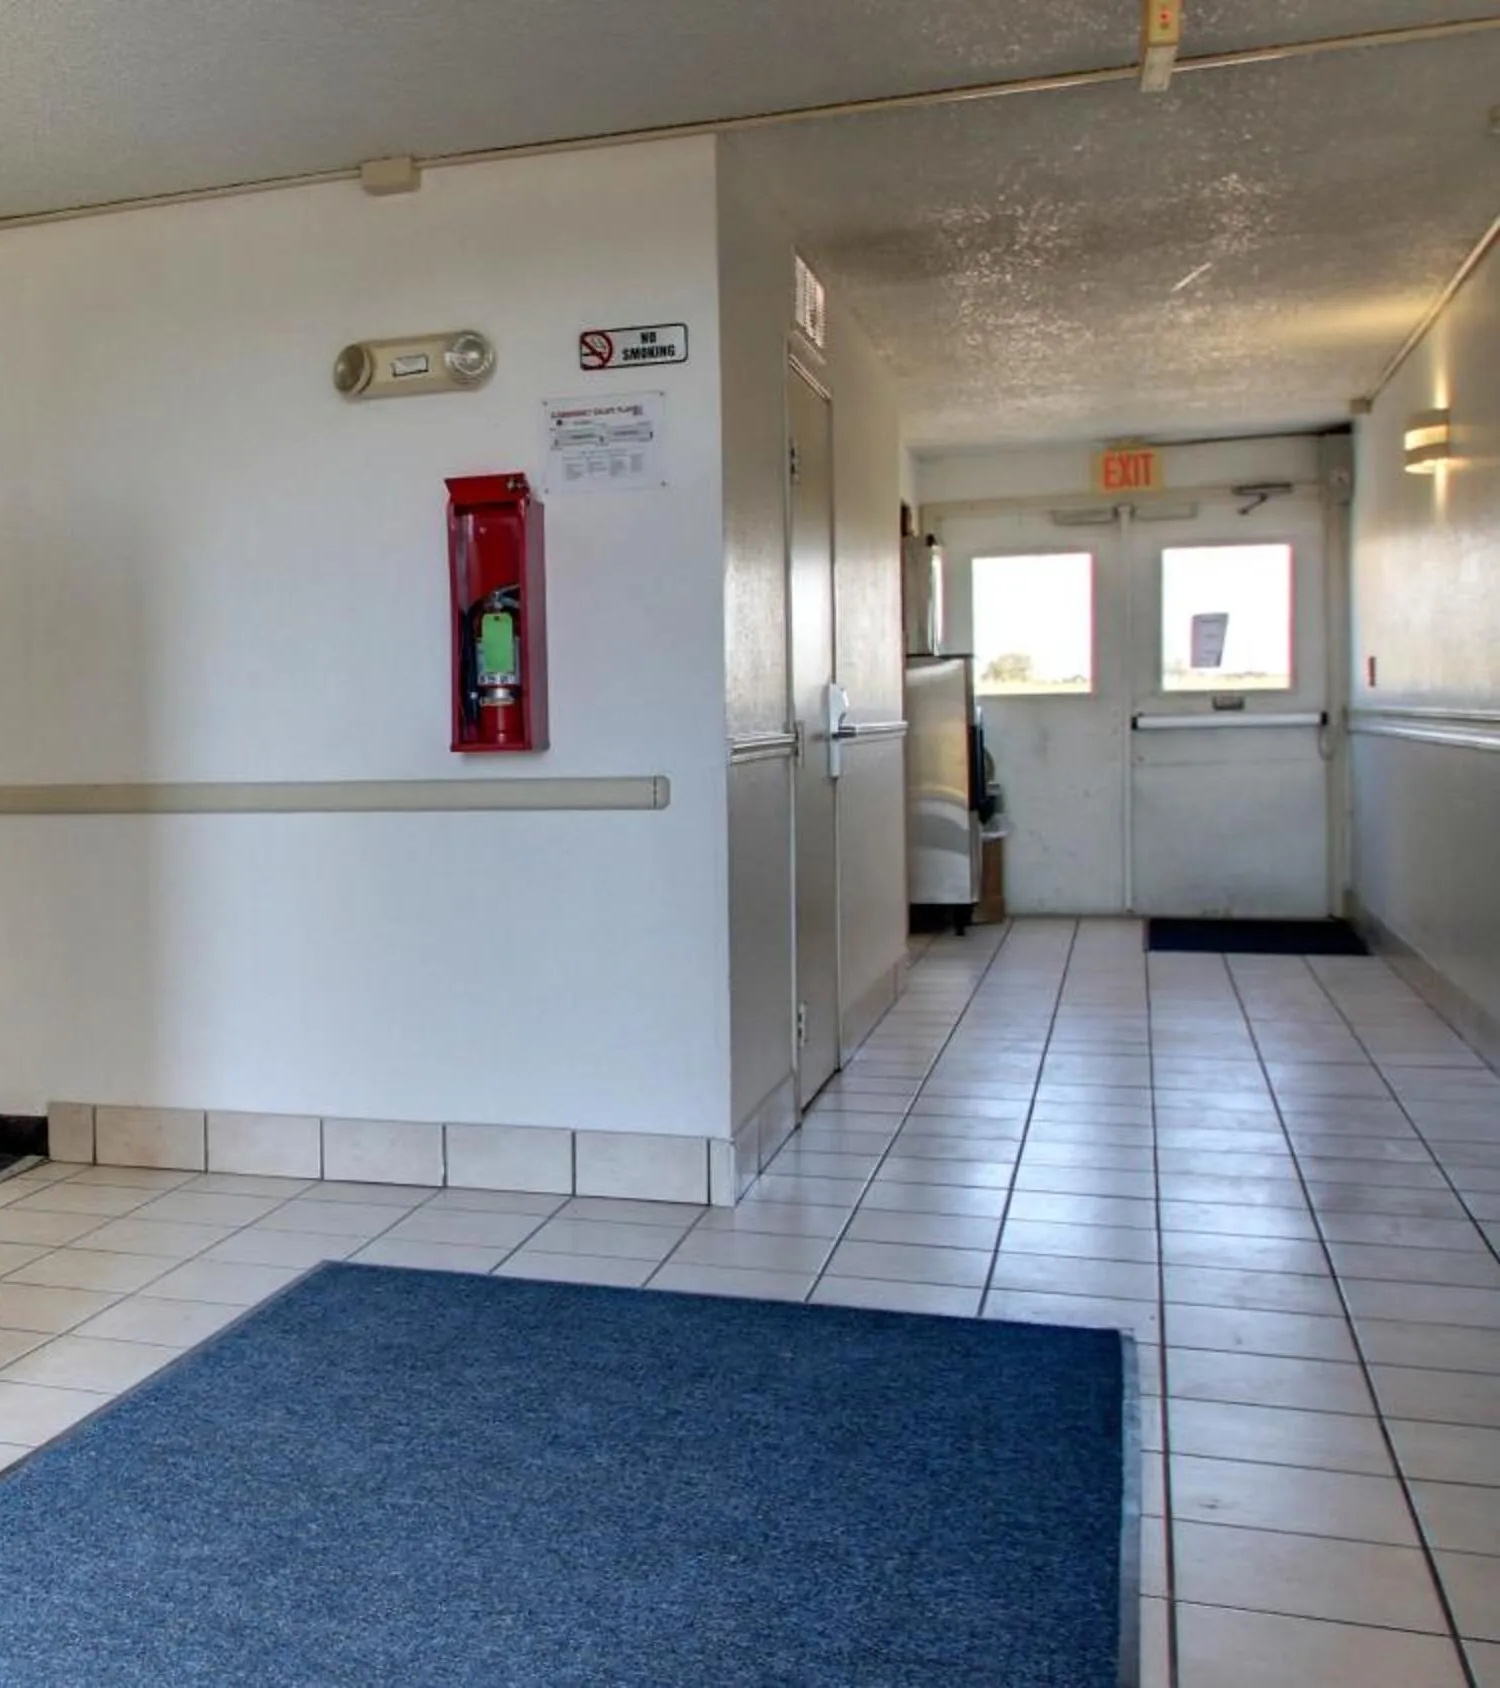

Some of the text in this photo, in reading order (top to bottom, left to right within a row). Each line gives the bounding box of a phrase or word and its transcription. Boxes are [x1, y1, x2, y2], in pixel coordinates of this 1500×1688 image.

[640, 331, 657, 344] NO
[621, 344, 676, 361] SMOKING
[1104, 453, 1155, 488] EXIT
